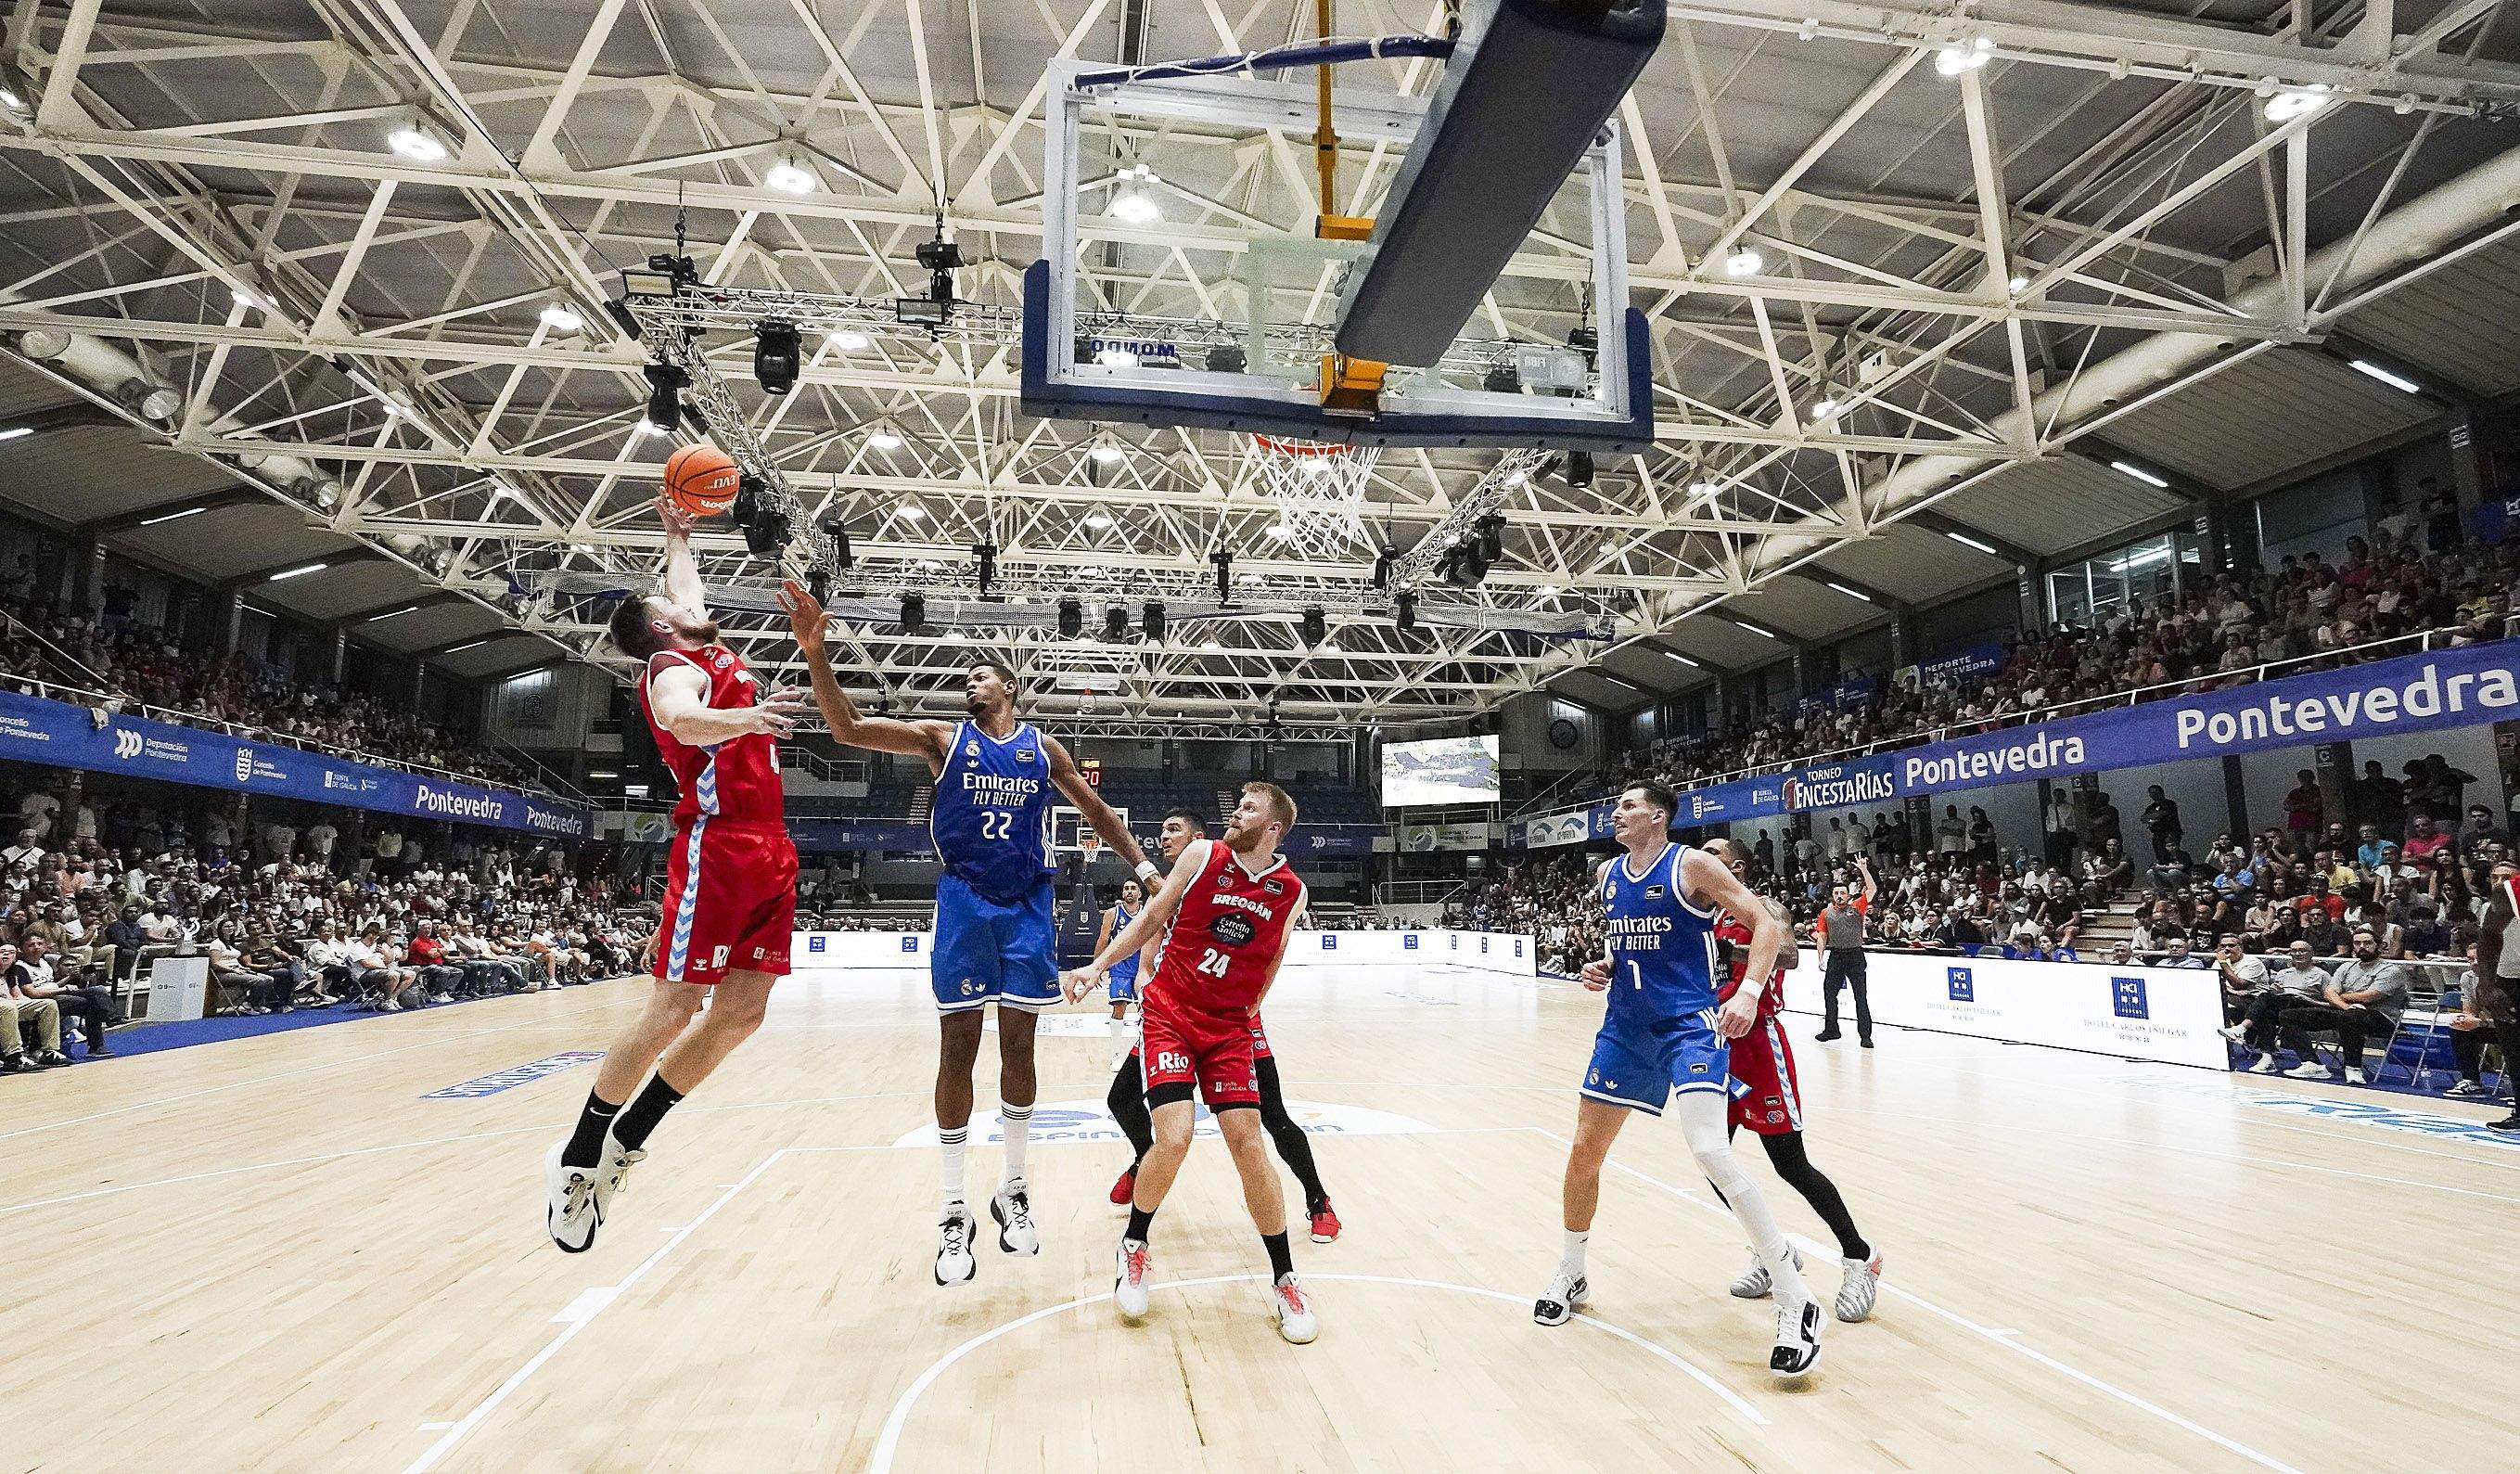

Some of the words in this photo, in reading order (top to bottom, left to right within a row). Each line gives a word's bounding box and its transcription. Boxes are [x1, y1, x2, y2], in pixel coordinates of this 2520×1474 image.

[2177, 664, 2519, 749] Pontevedra
[5, 726, 50, 741] Pontevedra
[146, 738, 188, 753] Deputación
[145, 749, 187, 763] Pontevedra
[1906, 731, 2085, 788] Pontevedra
[963, 772, 1039, 794] Emirates
[1807, 766, 1842, 782] TORNEO
[973, 791, 990, 805] FLY
[992, 791, 1028, 807] BETTER
[1795, 770, 1894, 810] ENCESTARÍAS
[416, 785, 503, 820] Pontevedra
[526, 805, 583, 835] Pontevedra
[980, 811, 1013, 840] 22
[1211, 893, 1273, 922] BREOGÁN
[1216, 925, 1245, 940] Galicia
[1219, 916, 1250, 934] Estrella
[1609, 915, 1672, 933] mirates
[1625, 934, 1660, 951] BETTER
[1196, 947, 1232, 979] 24
[1627, 959, 1642, 990] 1
[1158, 1051, 1189, 1070] Rio
